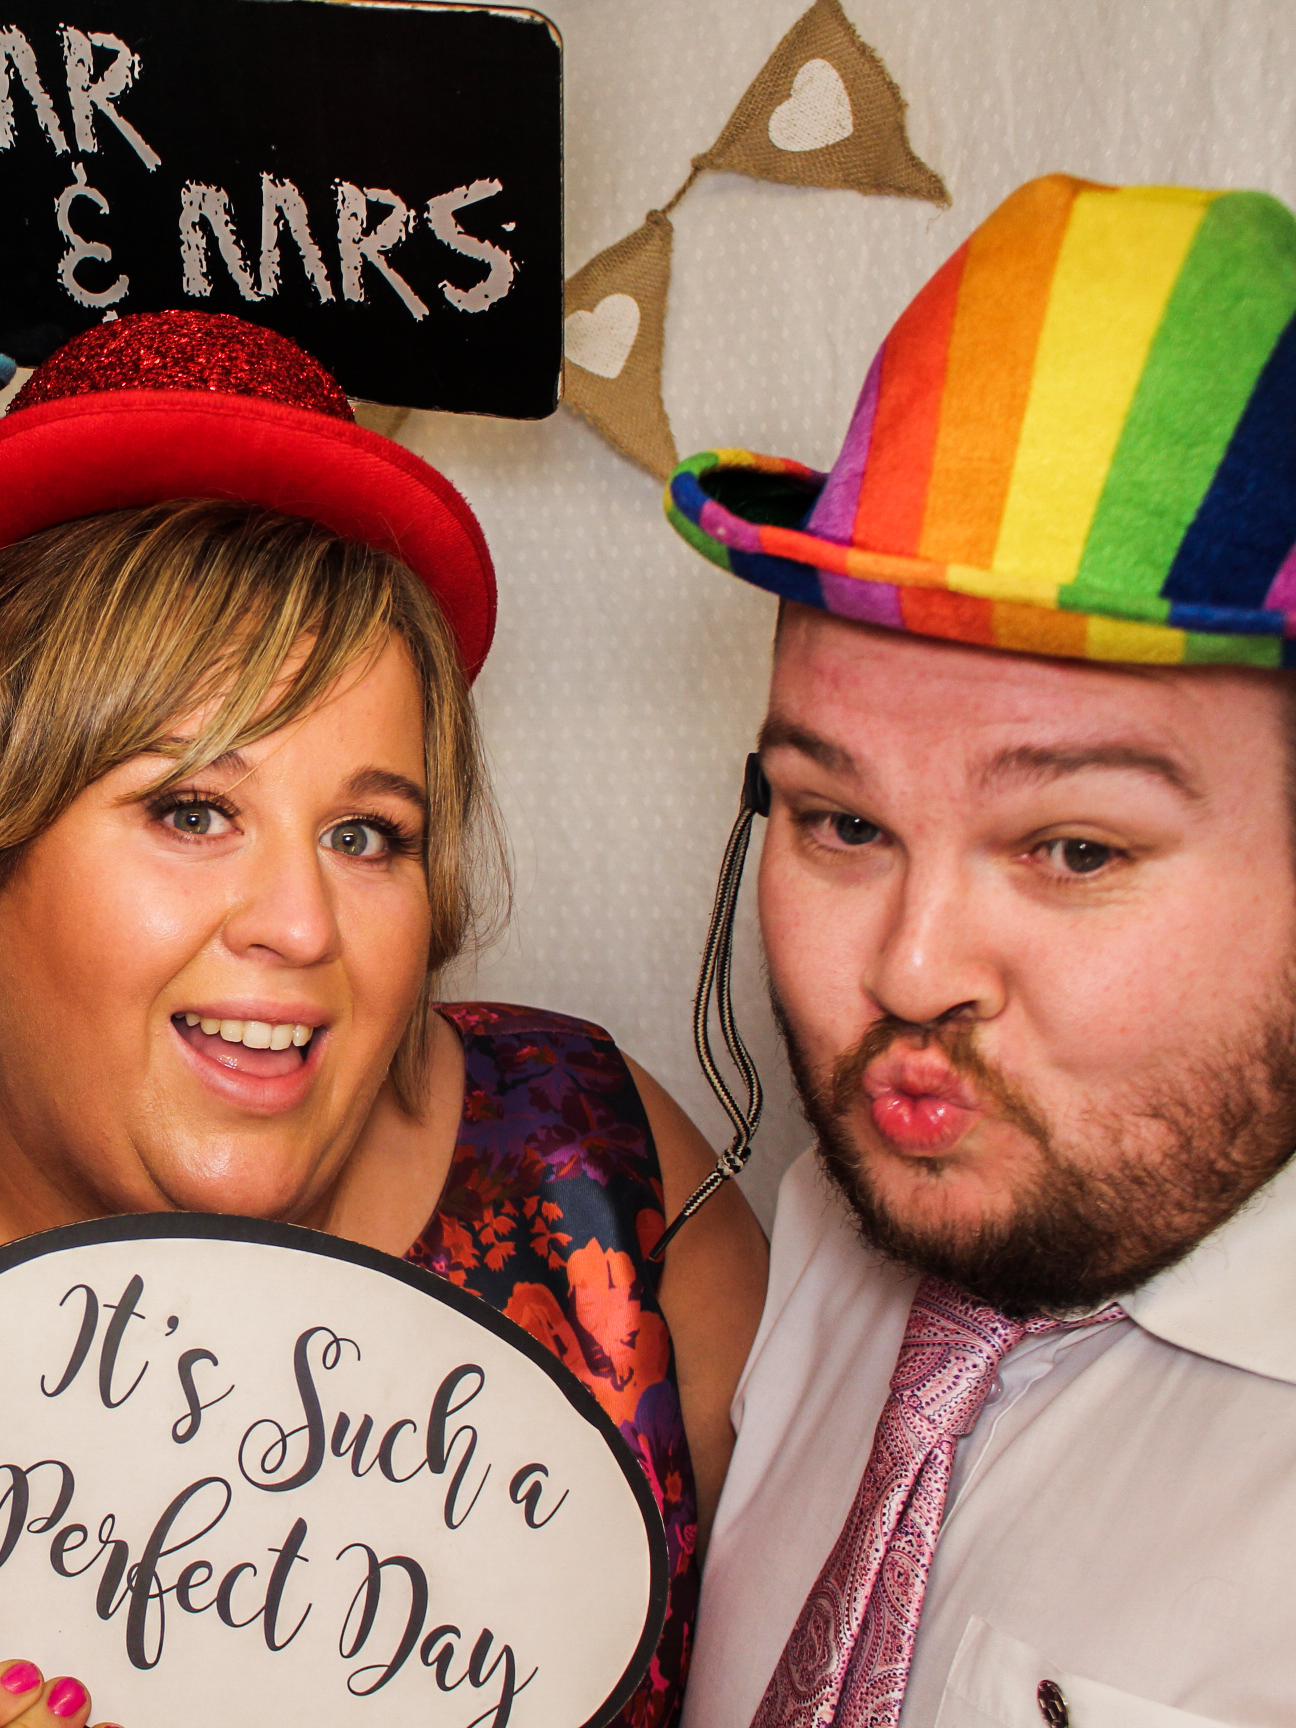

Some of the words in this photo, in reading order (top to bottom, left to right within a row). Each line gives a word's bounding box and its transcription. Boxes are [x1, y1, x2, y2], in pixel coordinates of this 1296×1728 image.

[54, 162, 129, 323] &
[179, 171, 520, 322] MRS
[40, 1274, 235, 1445] It's
[237, 1326, 492, 1530] Such
[508, 1462, 570, 1530] a
[335, 1542, 539, 1728] Day
